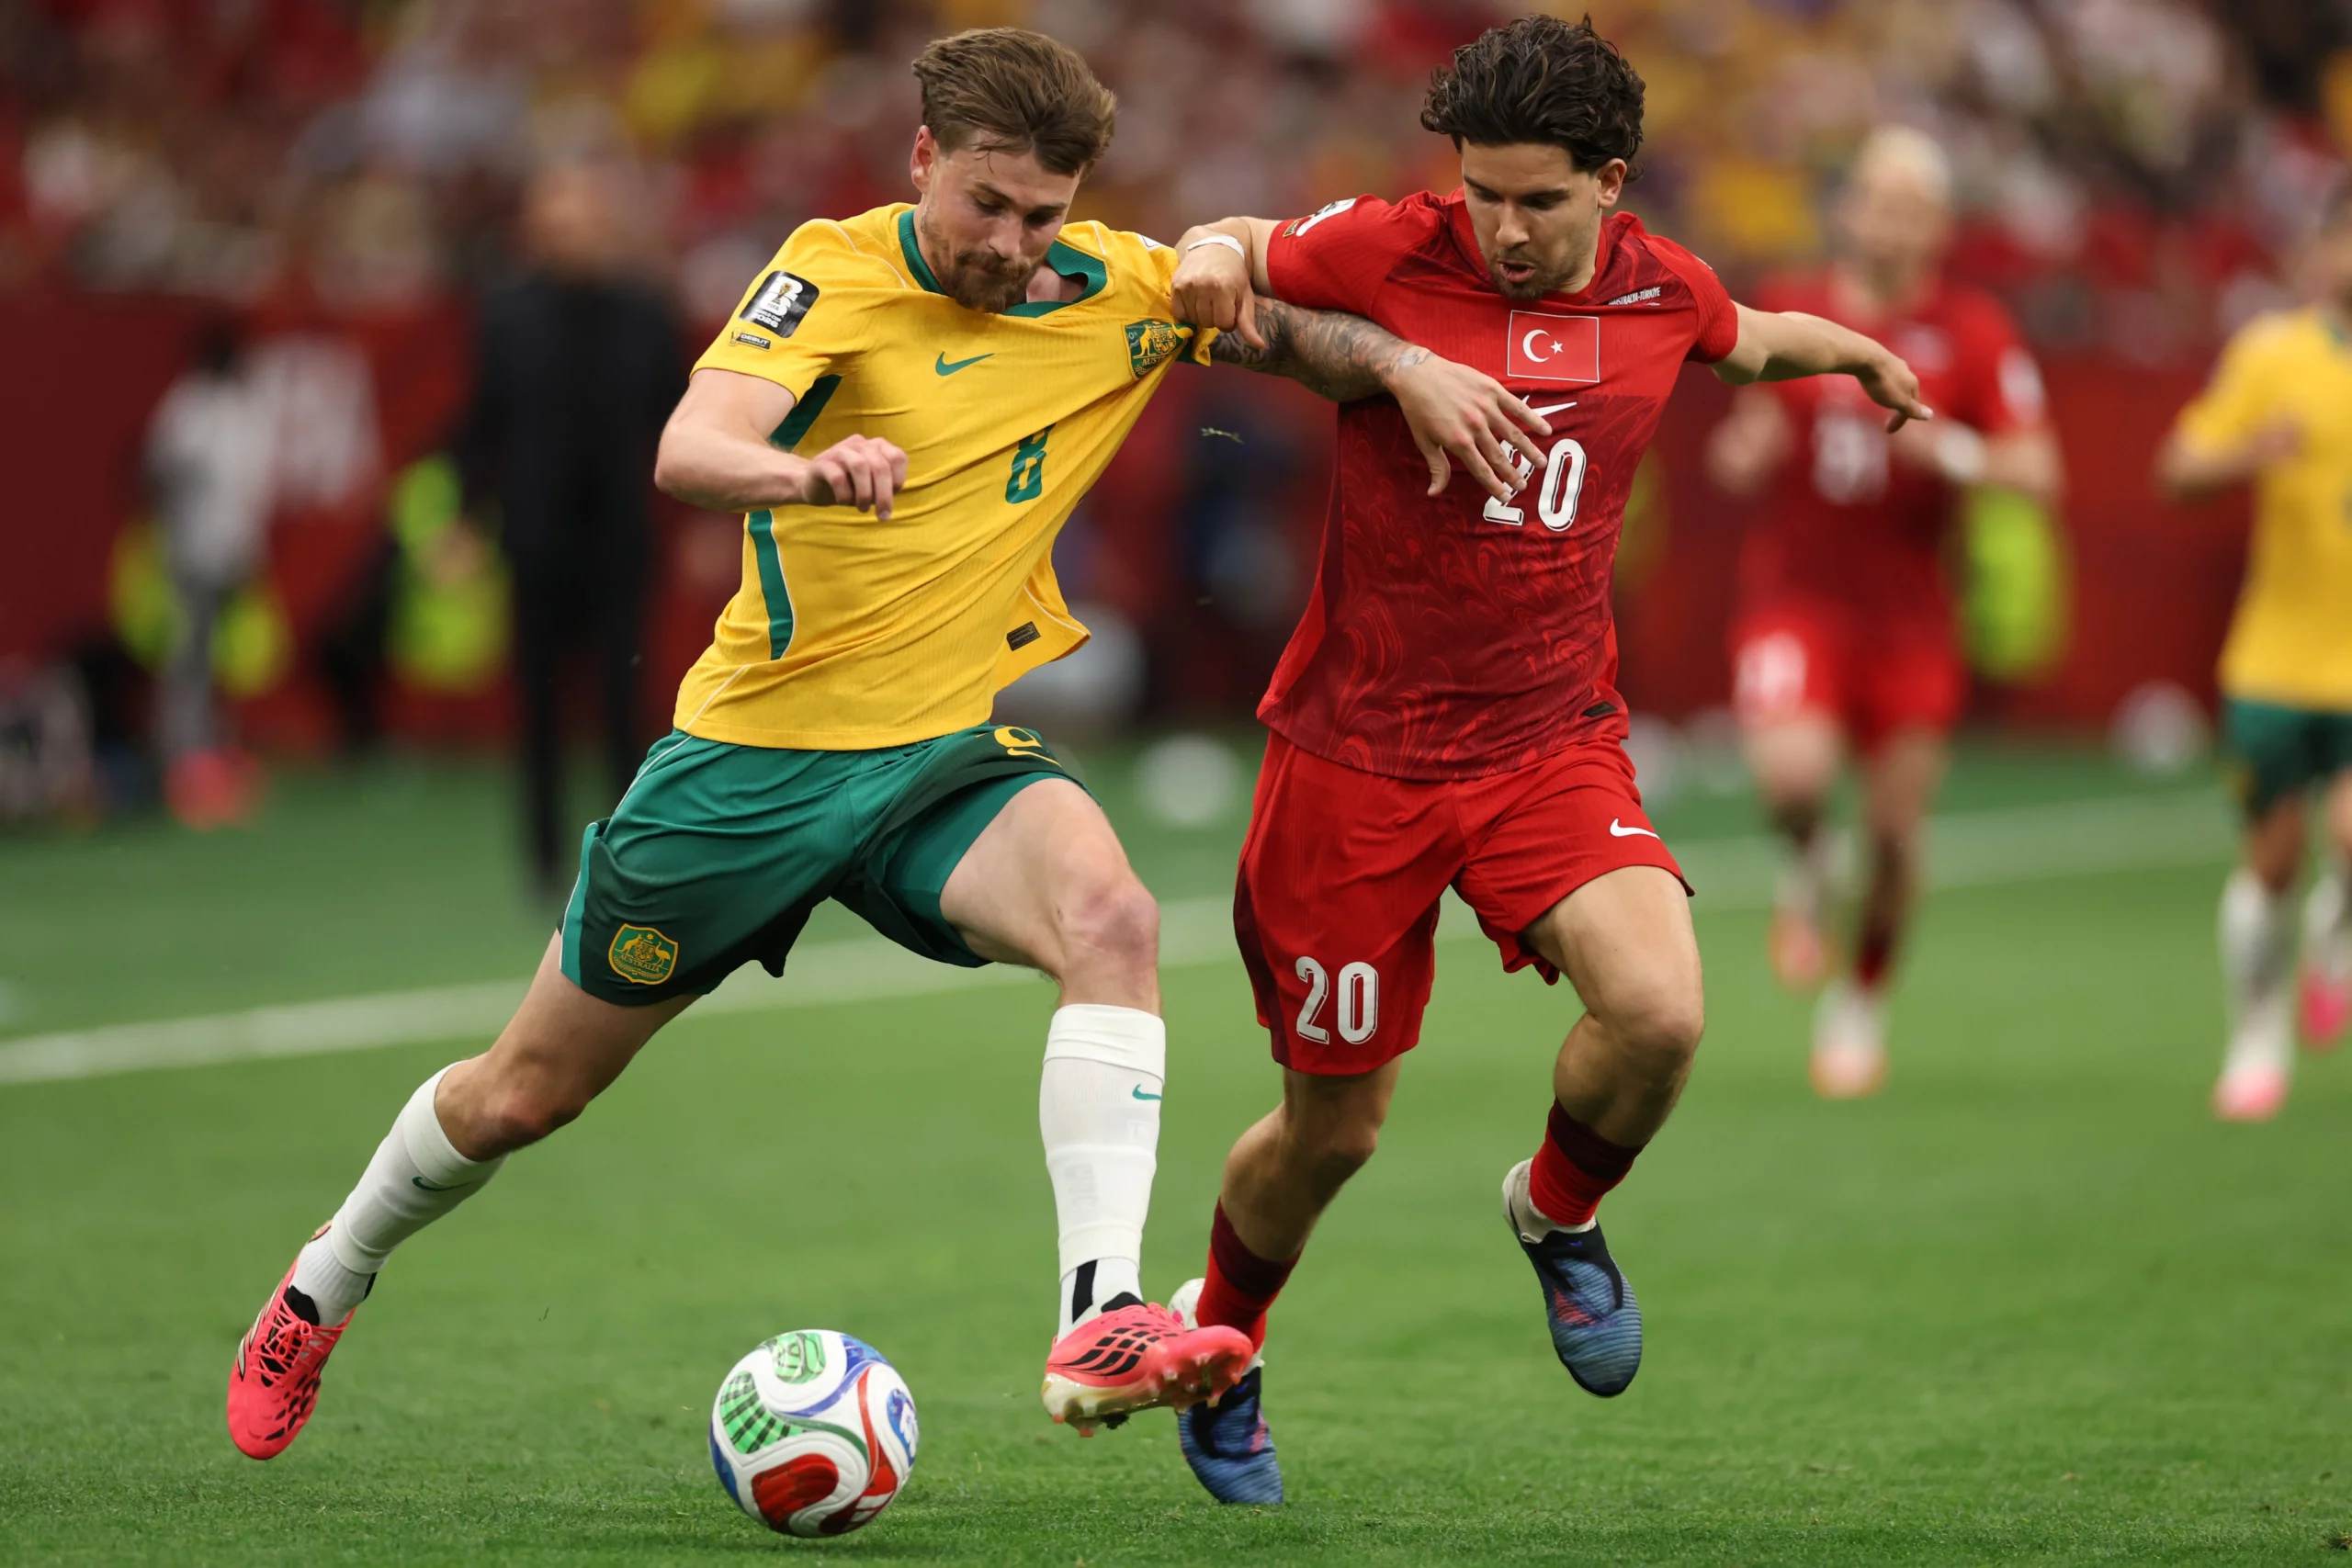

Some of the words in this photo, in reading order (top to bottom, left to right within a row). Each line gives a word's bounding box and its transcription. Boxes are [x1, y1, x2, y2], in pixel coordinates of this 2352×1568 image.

[767, 302, 779, 310] FIFA
[741, 333, 769, 344] DEBUT
[1005, 423, 1056, 503] 8
[620, 954, 660, 972] AUSTRALIA
[1295, 955, 1379, 1045] 20
